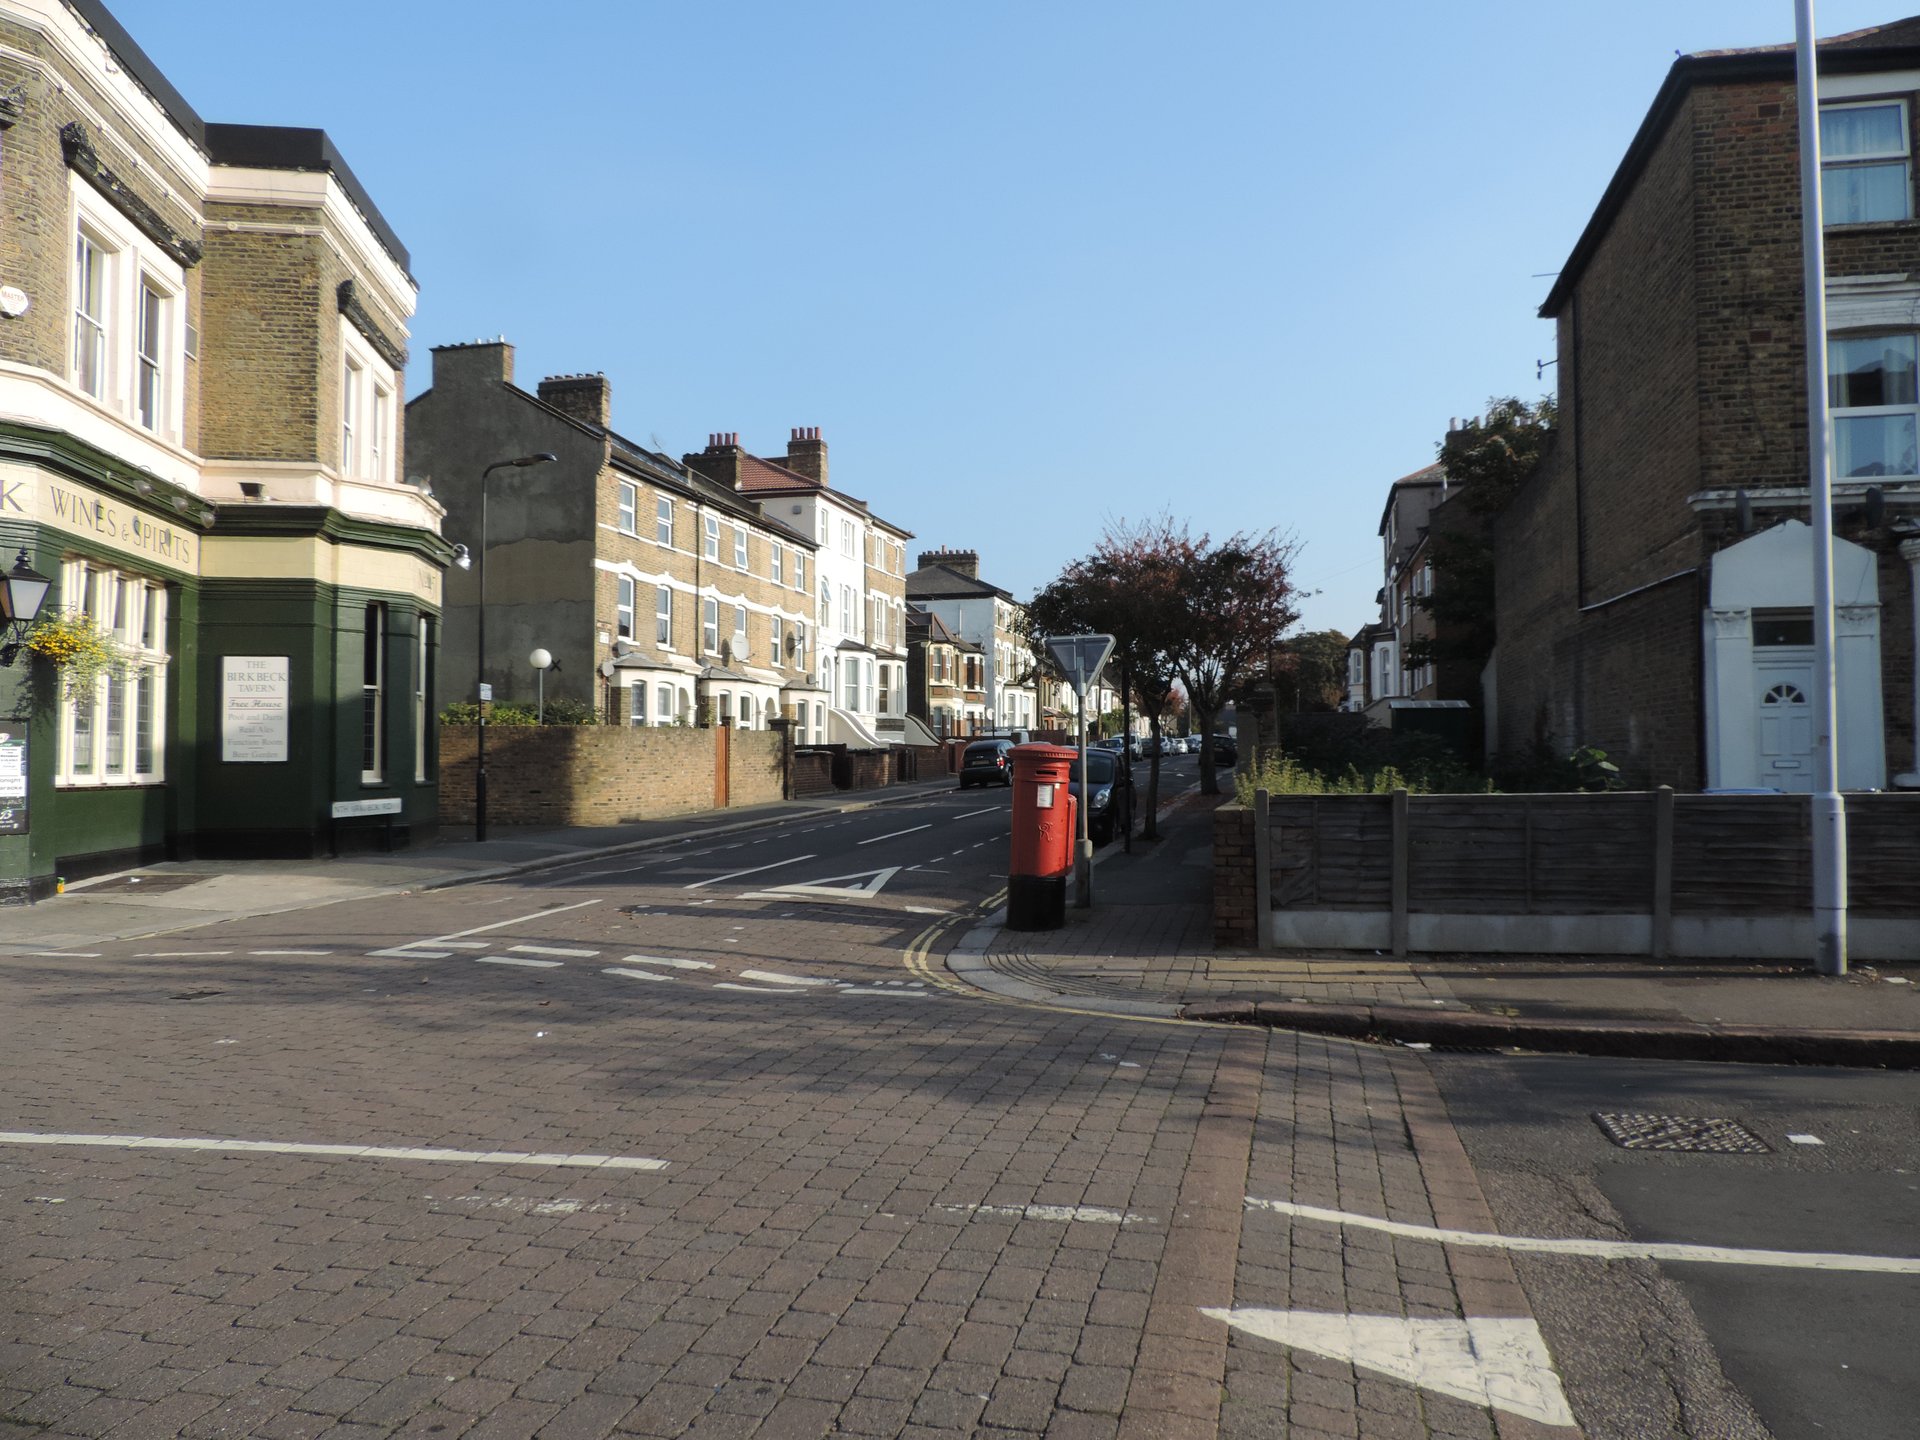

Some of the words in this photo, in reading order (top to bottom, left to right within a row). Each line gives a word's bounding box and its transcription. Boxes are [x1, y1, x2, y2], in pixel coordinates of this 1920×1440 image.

[50, 485, 117, 537] WINES
[121, 523, 129, 542] &
[133, 518, 190, 564] SPIRITS
[247, 660, 267, 669] THE
[227, 672, 287, 682] BIRKBECK
[238, 684, 276, 693] TAVERN
[228, 699, 249, 708] Free
[251, 699, 282, 708] House
[246, 713, 260, 721] and
